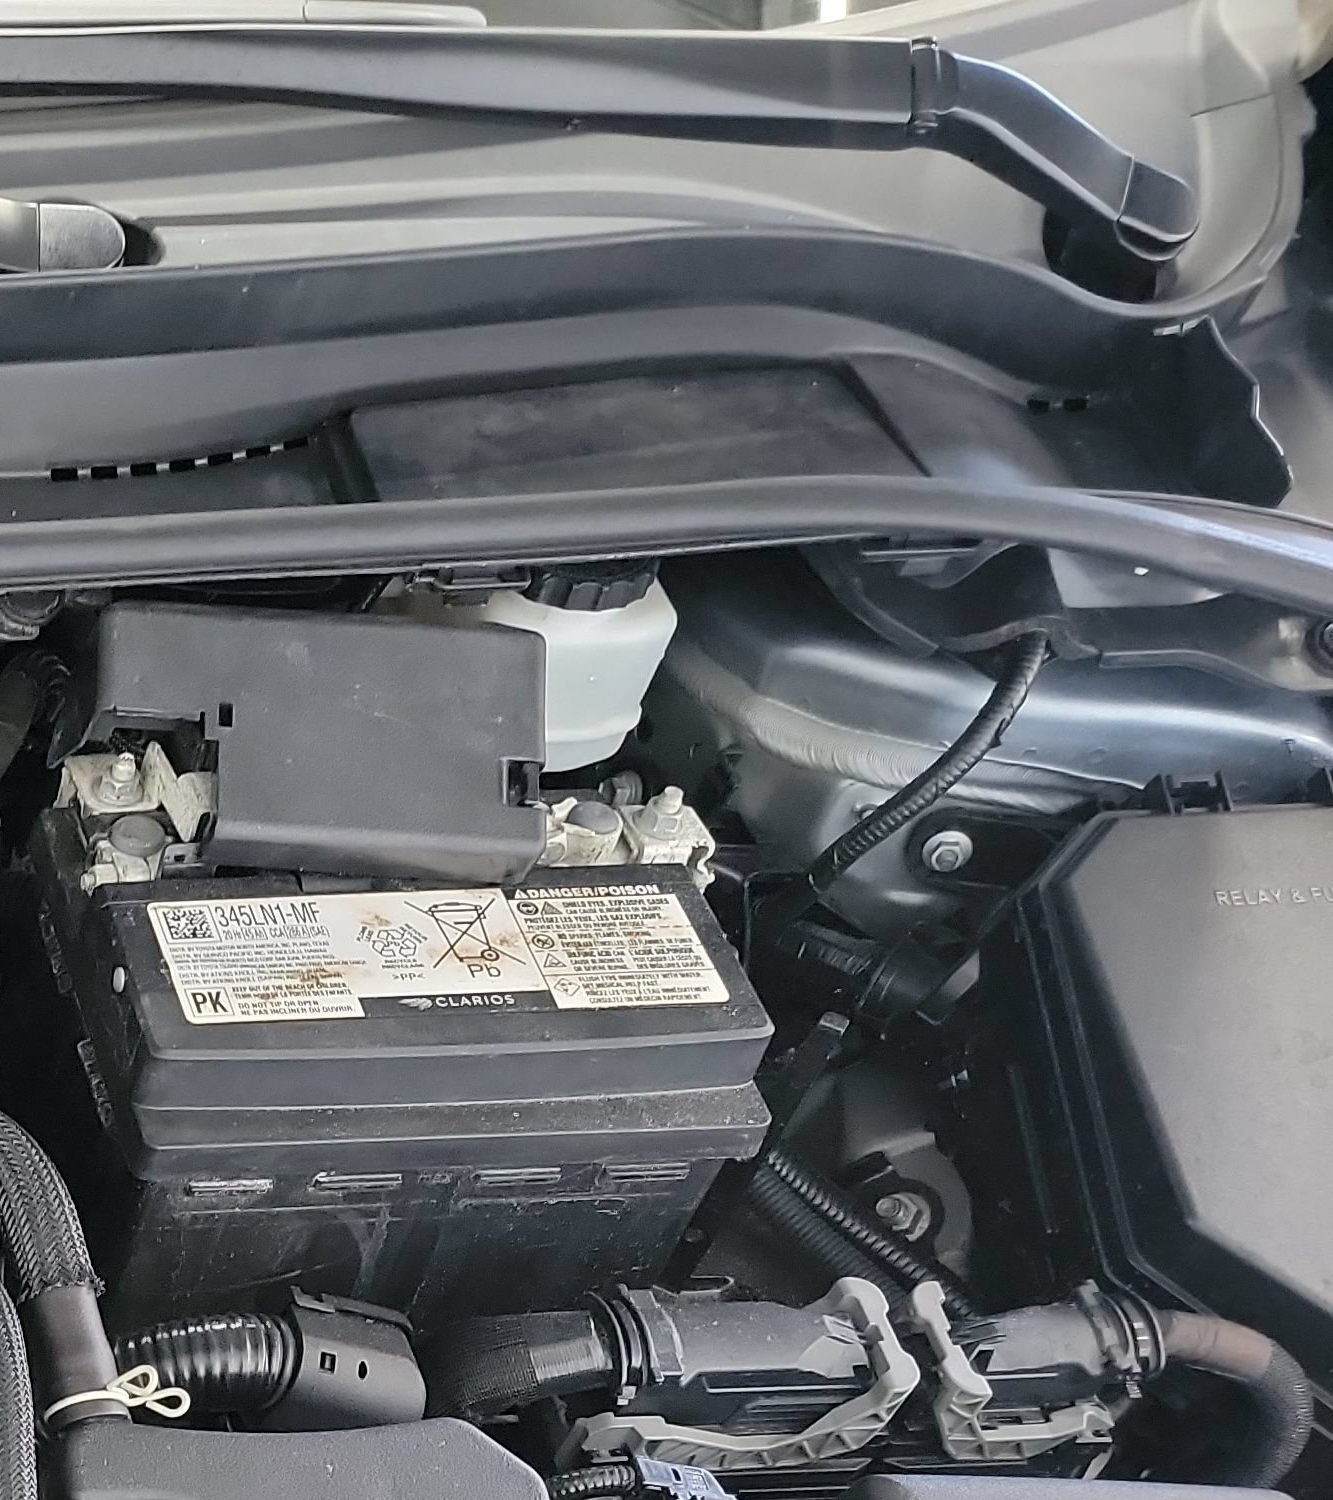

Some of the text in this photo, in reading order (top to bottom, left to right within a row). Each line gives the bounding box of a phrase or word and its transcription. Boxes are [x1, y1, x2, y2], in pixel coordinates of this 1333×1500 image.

[526, 884, 660, 899] DANGER/POISON
[1214, 888, 1281, 905] RELAY
[1290, 888, 1307, 903] &
[215, 901, 320, 927] 345LN1-MF
[468, 964, 501, 978] Pb
[191, 991, 228, 1013] PK
[435, 995, 515, 1008] CLARIOS
